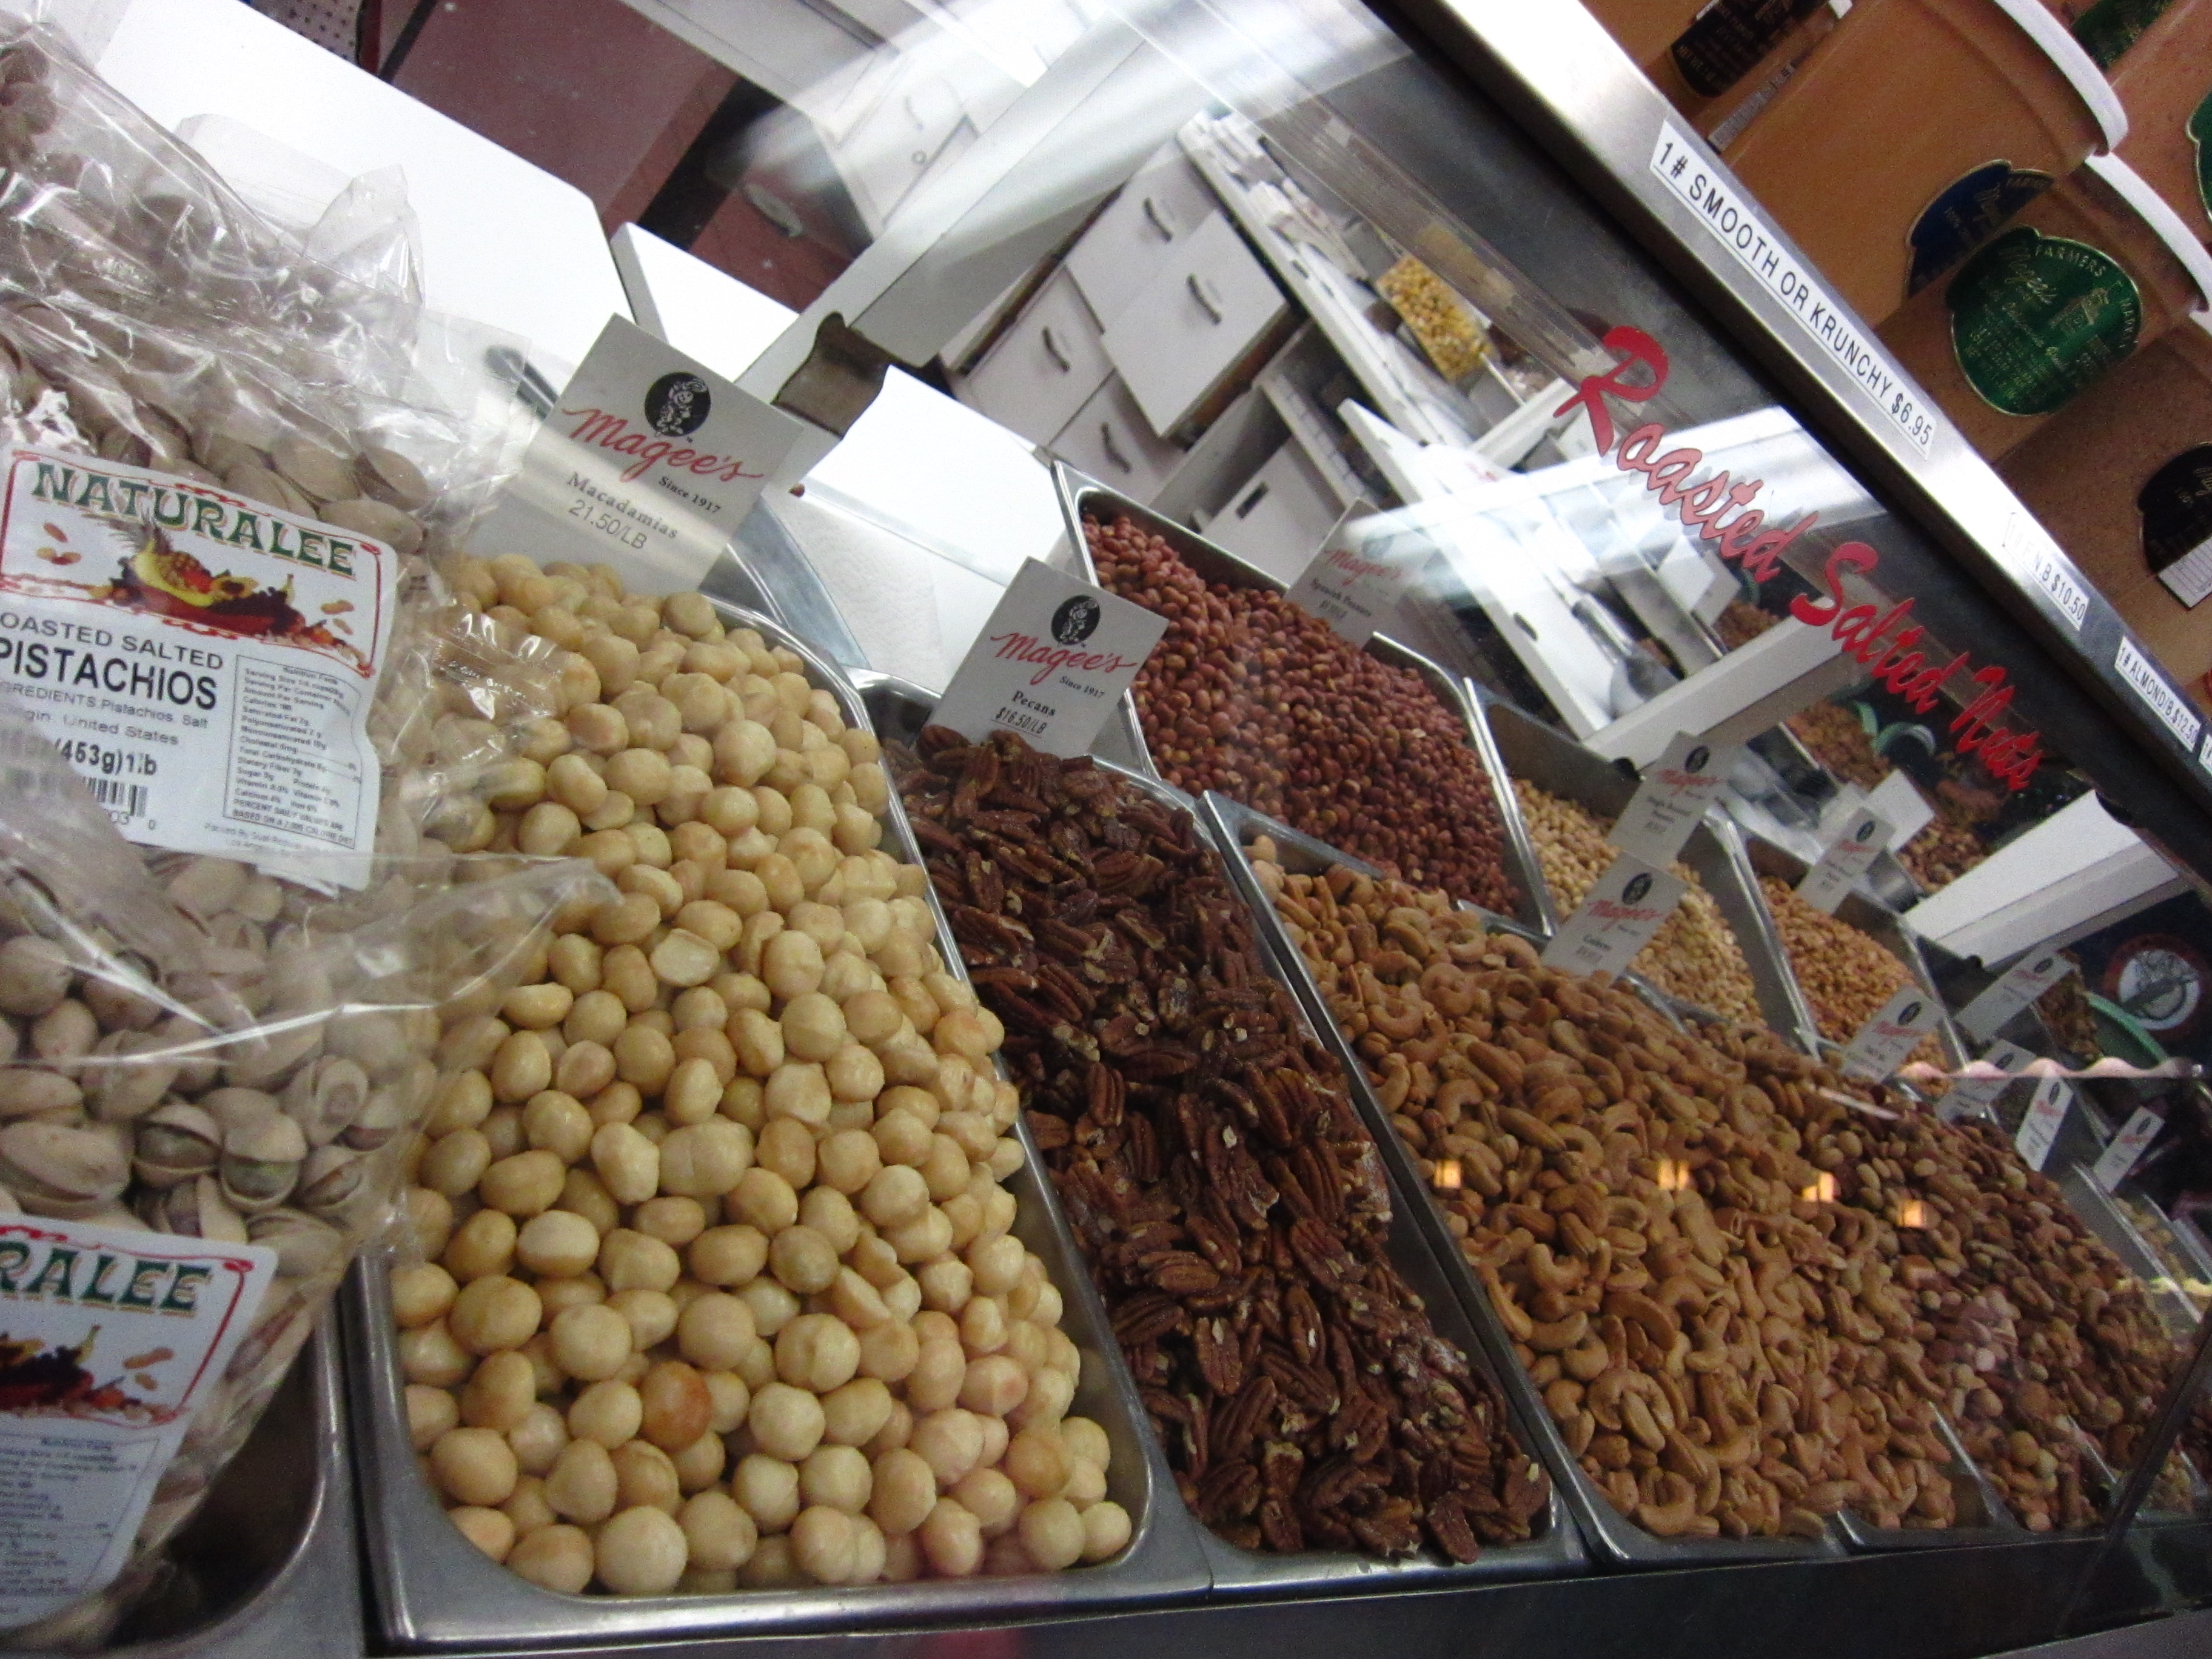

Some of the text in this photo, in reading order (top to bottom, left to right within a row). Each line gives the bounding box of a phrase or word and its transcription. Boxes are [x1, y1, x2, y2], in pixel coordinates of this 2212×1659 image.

[1689, 174, 1780, 279] SMOOTH
[1780, 271, 1809, 312] OR
[1809, 302, 1892, 398] KRUNCHY
[1891, 391, 1934, 446] $6.95
[561, 408, 765, 483] Magee's
[31, 461, 359, 578] NATURALEE
[567, 471, 680, 539] Macadamias
[658, 475, 722, 514] Since 1917
[569, 499, 648, 550] 21.50/LB
[1552, 326, 1818, 583] Roasted
[1789, 541, 1970, 715] Salted
[1951, 666, 2042, 792] Nuts
[2051, 574, 2086, 620] $10.50
[0, 612, 224, 670] OASTED SALTED
[990, 632, 1138, 686] Magee's
[1011, 690, 1056, 717] Pecans
[1059, 675, 1105, 699] Since 1917
[125, 725, 178, 745] States
[996, 706, 1047, 734] $16.50/LB
[0, 1240, 212, 1316] RALEE
